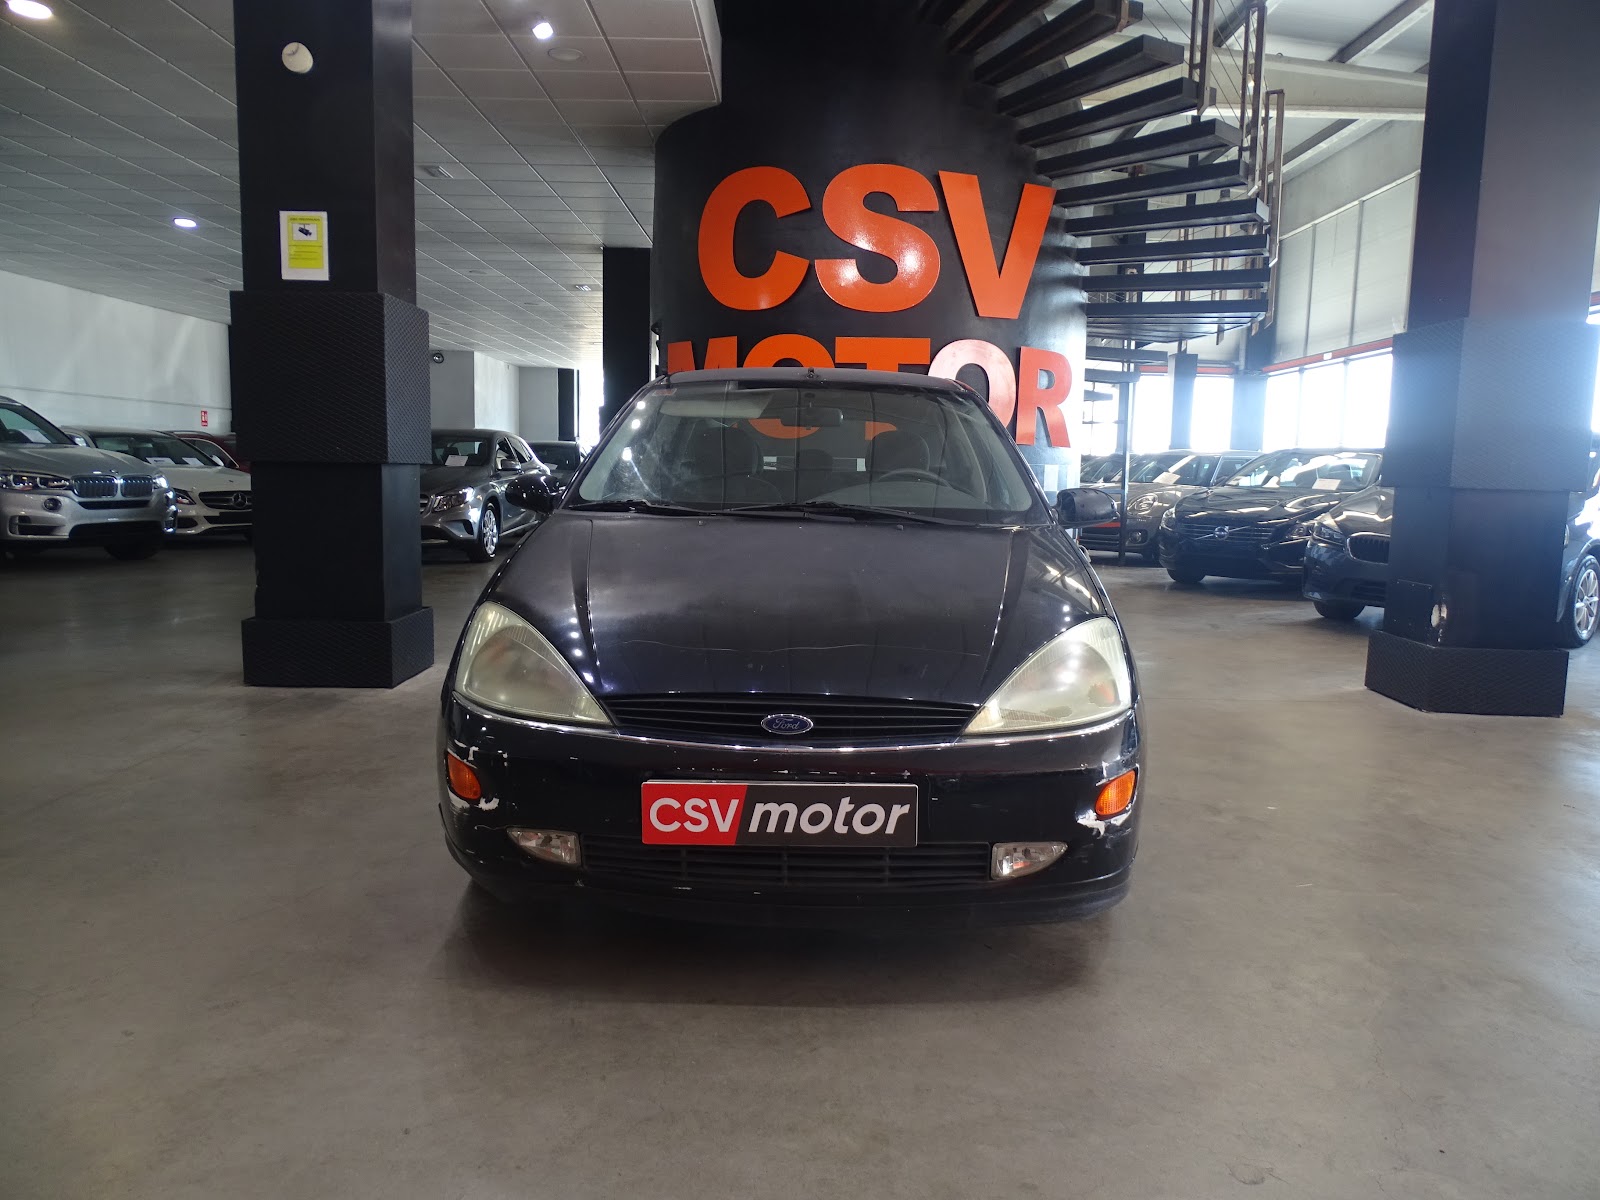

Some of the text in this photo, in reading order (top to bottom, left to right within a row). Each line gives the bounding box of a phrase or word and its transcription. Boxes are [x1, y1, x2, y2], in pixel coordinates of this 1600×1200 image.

[698, 163, 1057, 320] CSV
[772, 717, 801, 730] Ford
[649, 796, 911, 835] CSV motor
